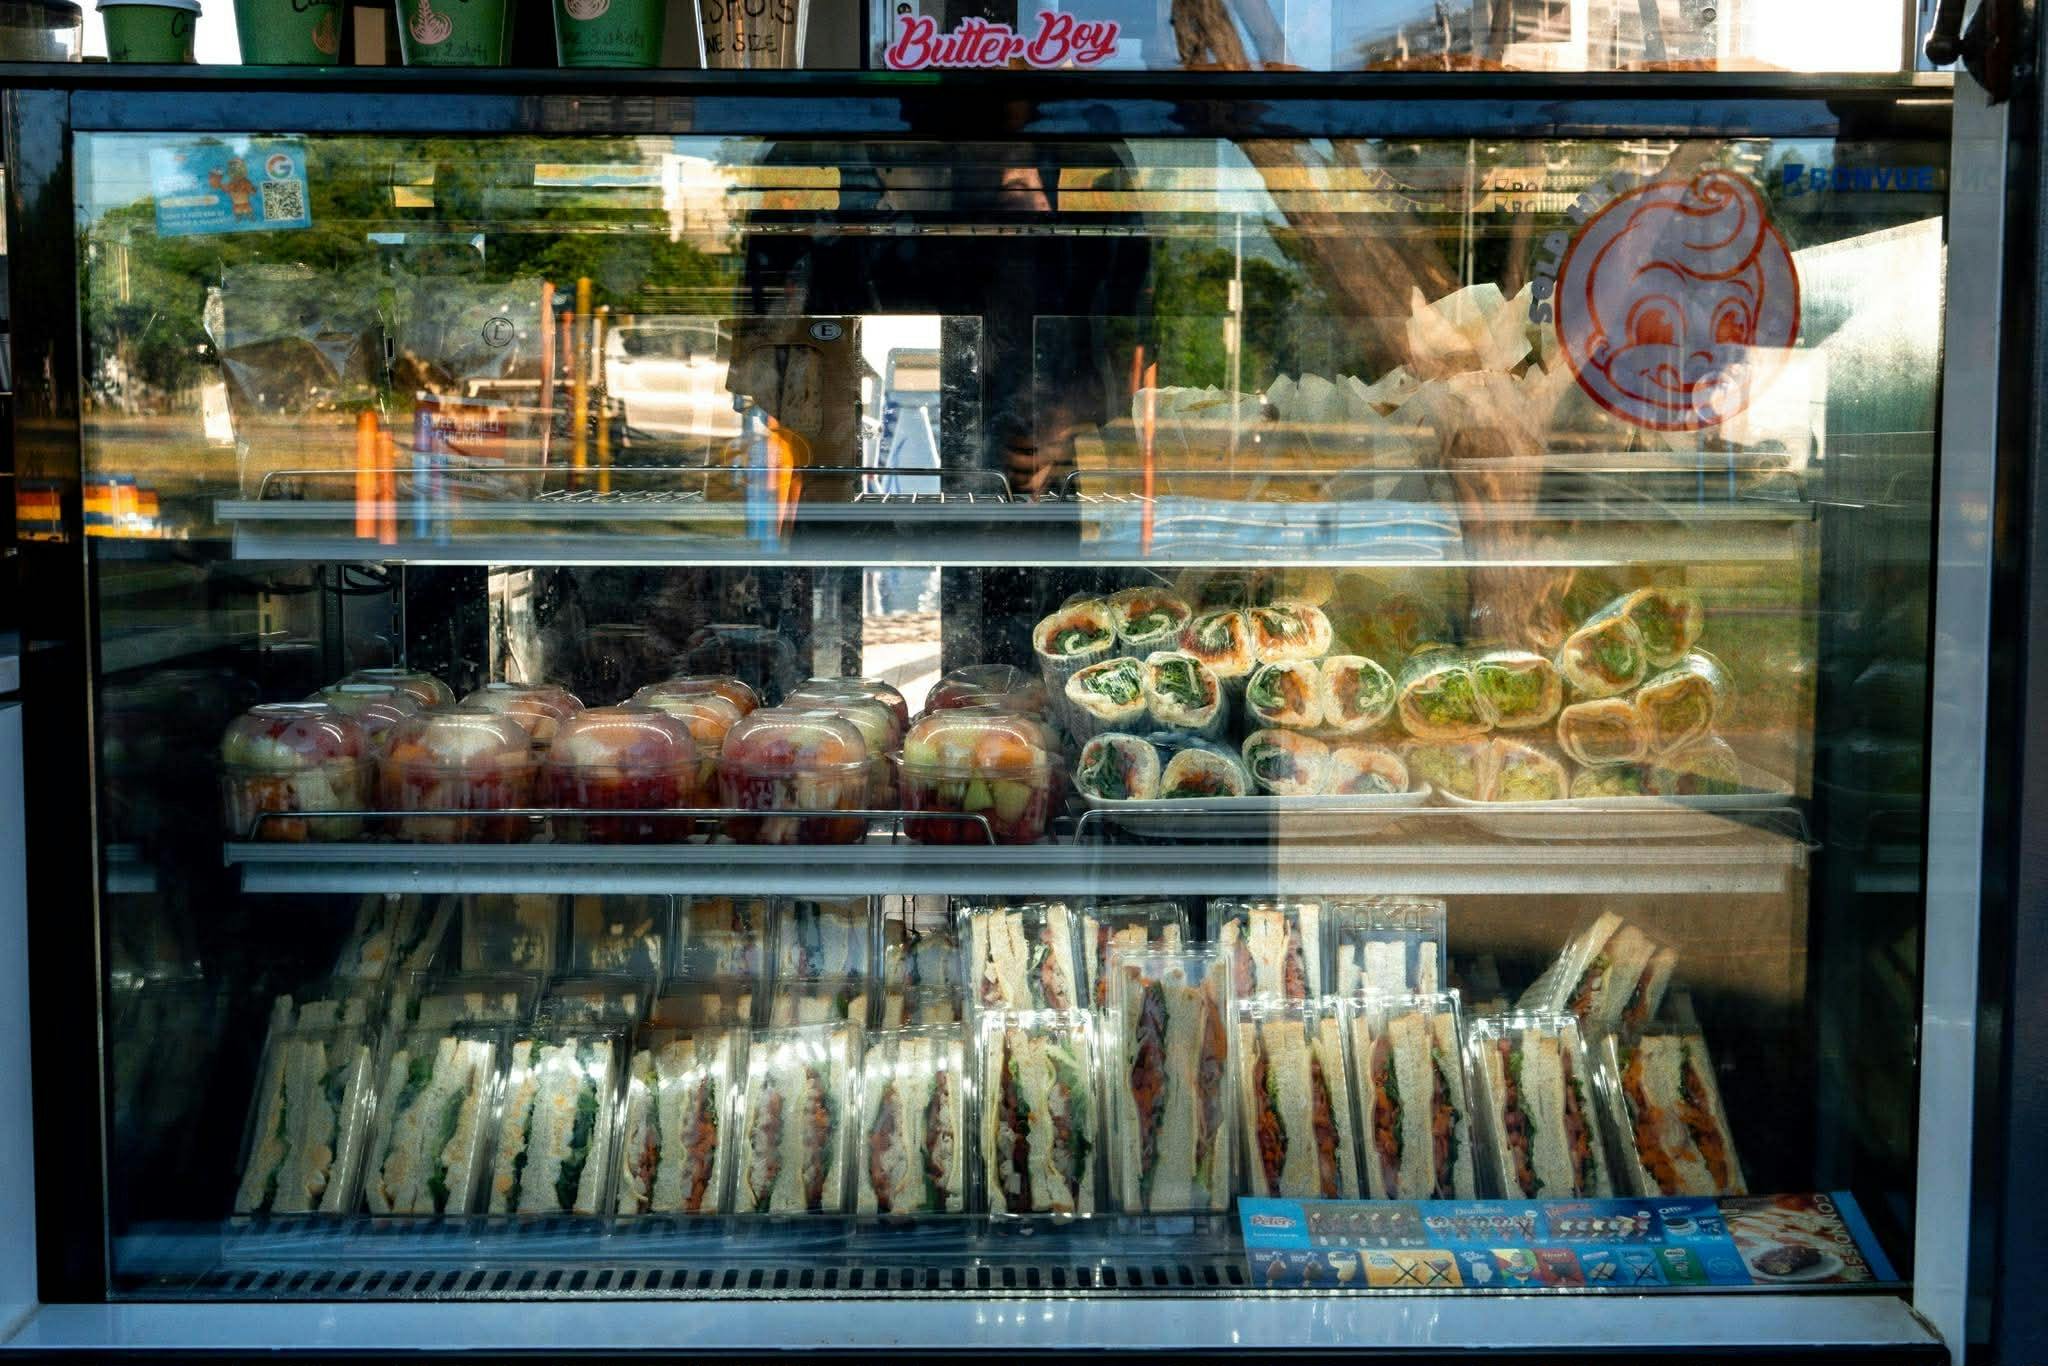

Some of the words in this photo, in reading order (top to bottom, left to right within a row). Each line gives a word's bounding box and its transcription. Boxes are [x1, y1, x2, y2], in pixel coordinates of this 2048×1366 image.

[888, 15, 1023, 69] Butter
[1026, 11, 1118, 64] Boy
[1810, 166, 1935, 192] BONVUE
